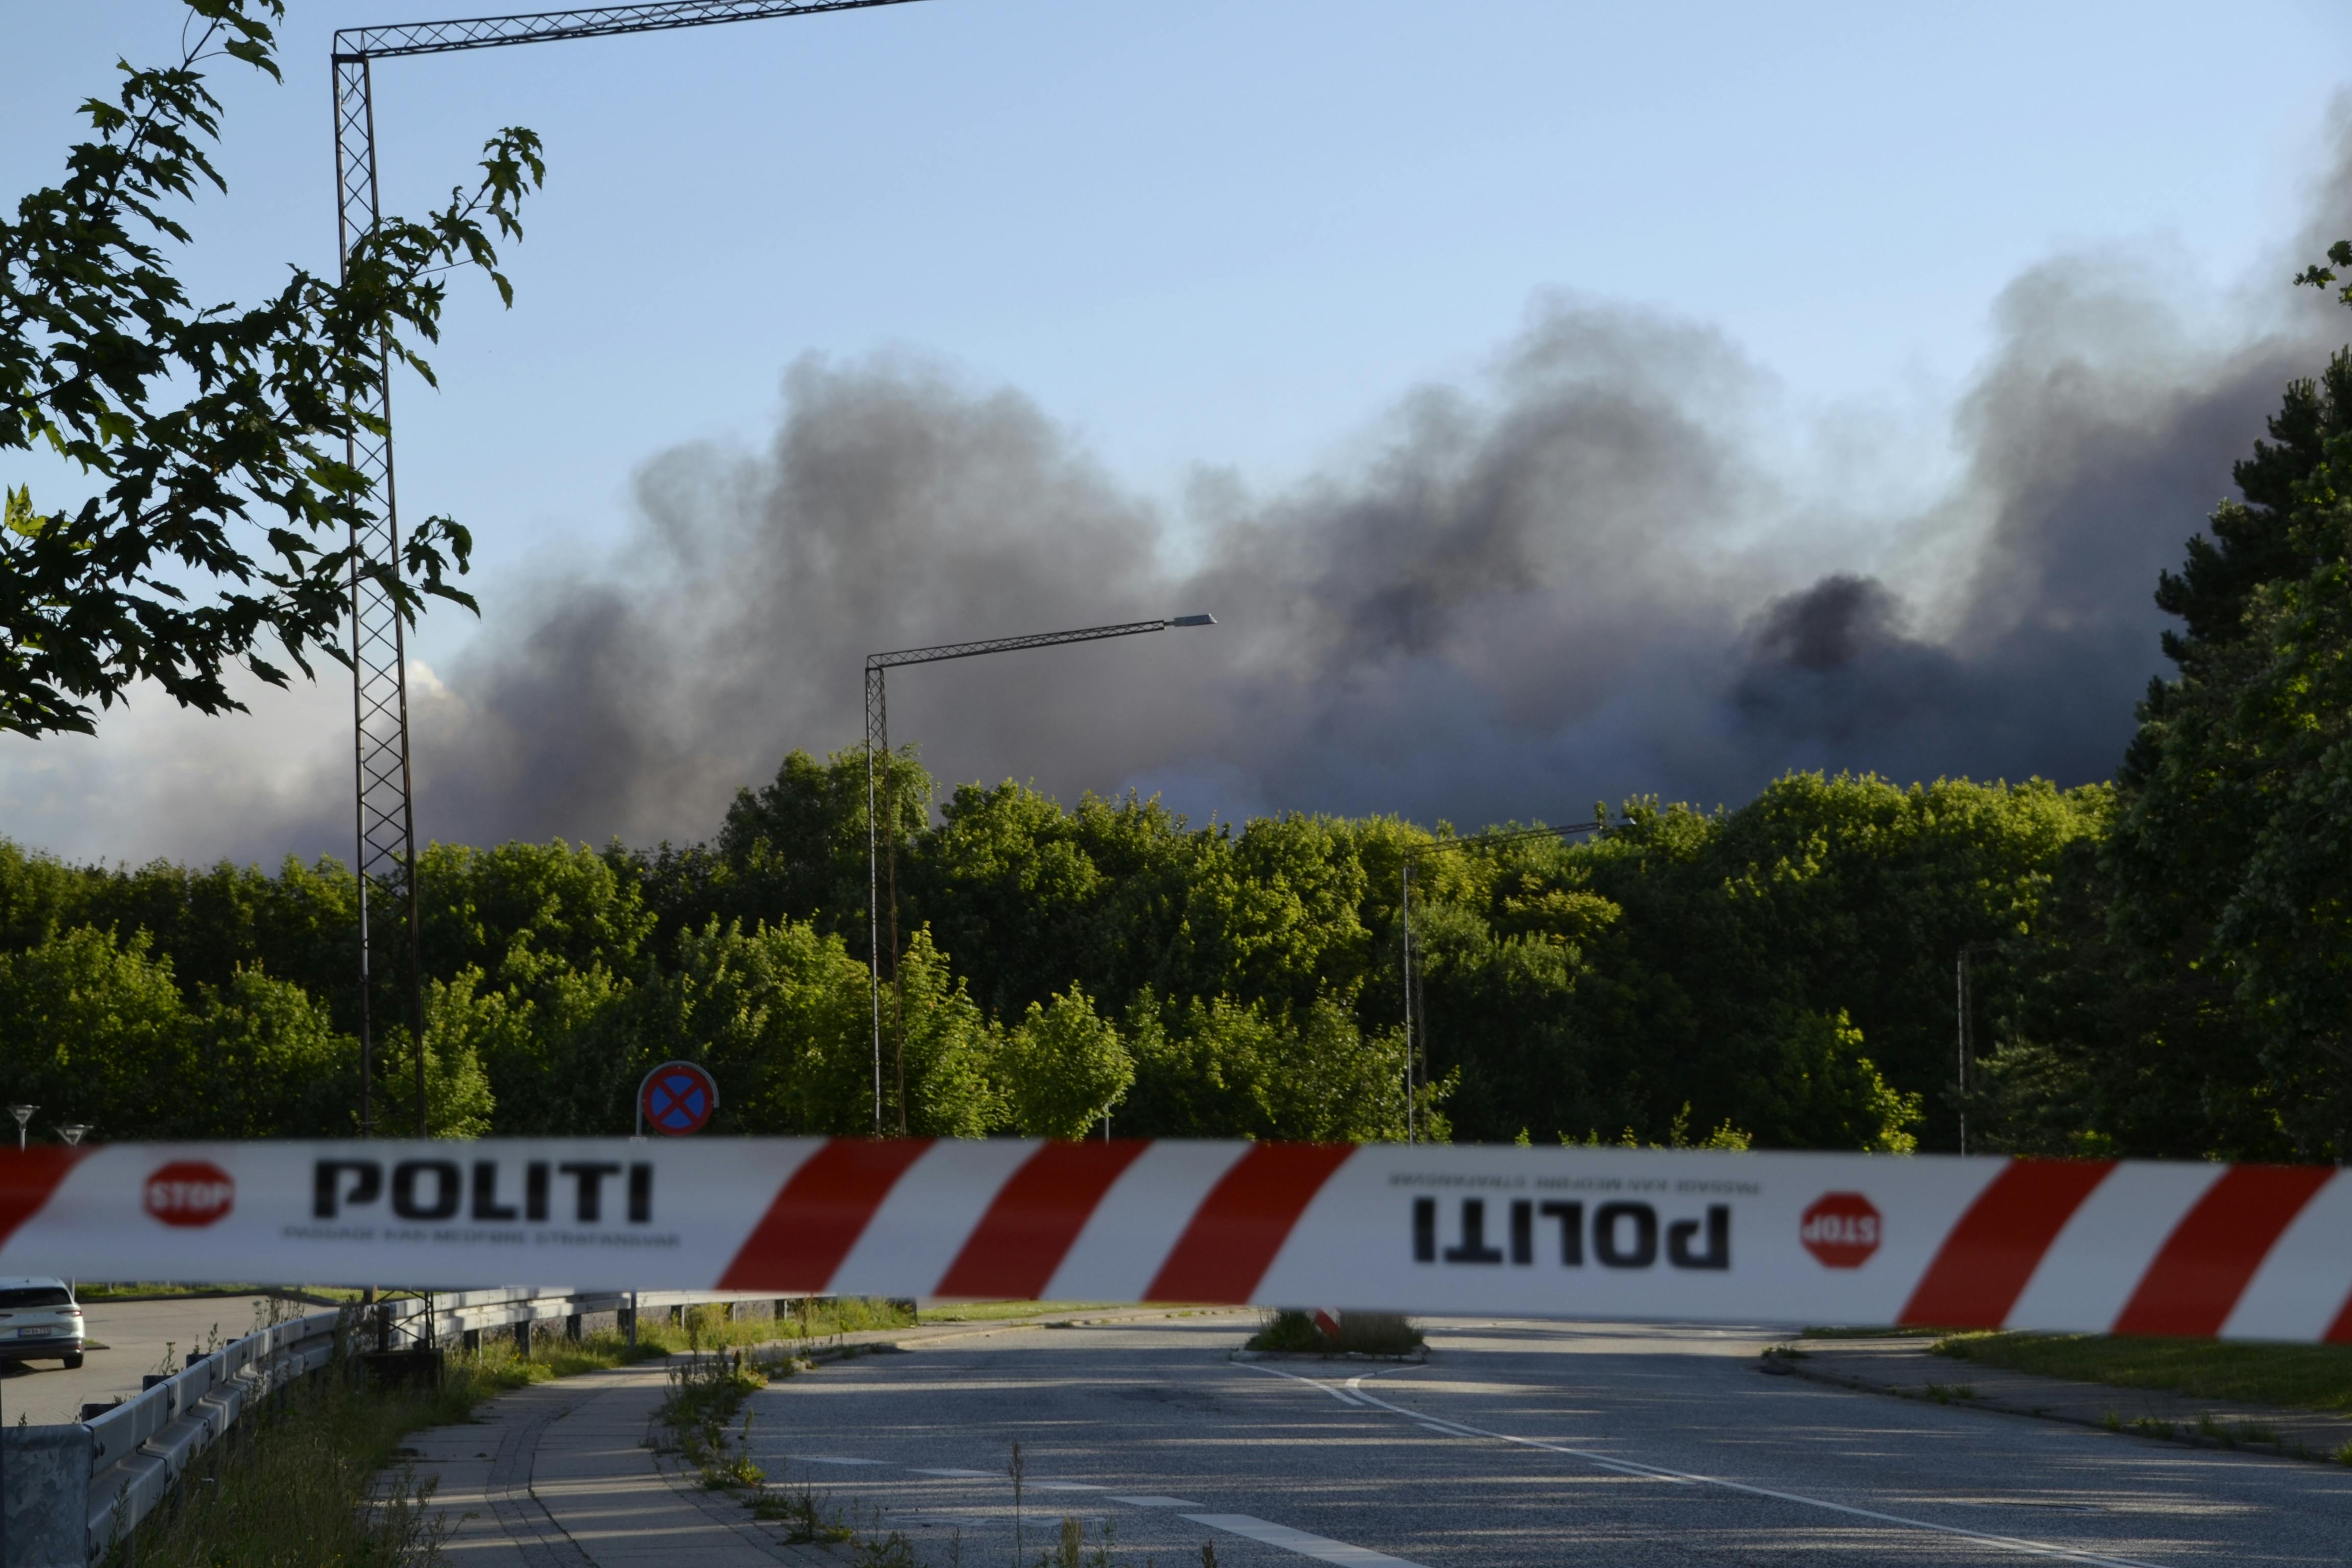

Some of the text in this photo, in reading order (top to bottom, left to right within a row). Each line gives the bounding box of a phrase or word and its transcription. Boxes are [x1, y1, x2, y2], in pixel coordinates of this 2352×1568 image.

[150, 1180, 233, 1210] STOP
[312, 1158, 653, 1223] POLITI
[1413, 1197, 1730, 1269] POLITI
[1802, 1214, 1876, 1243] STOP
